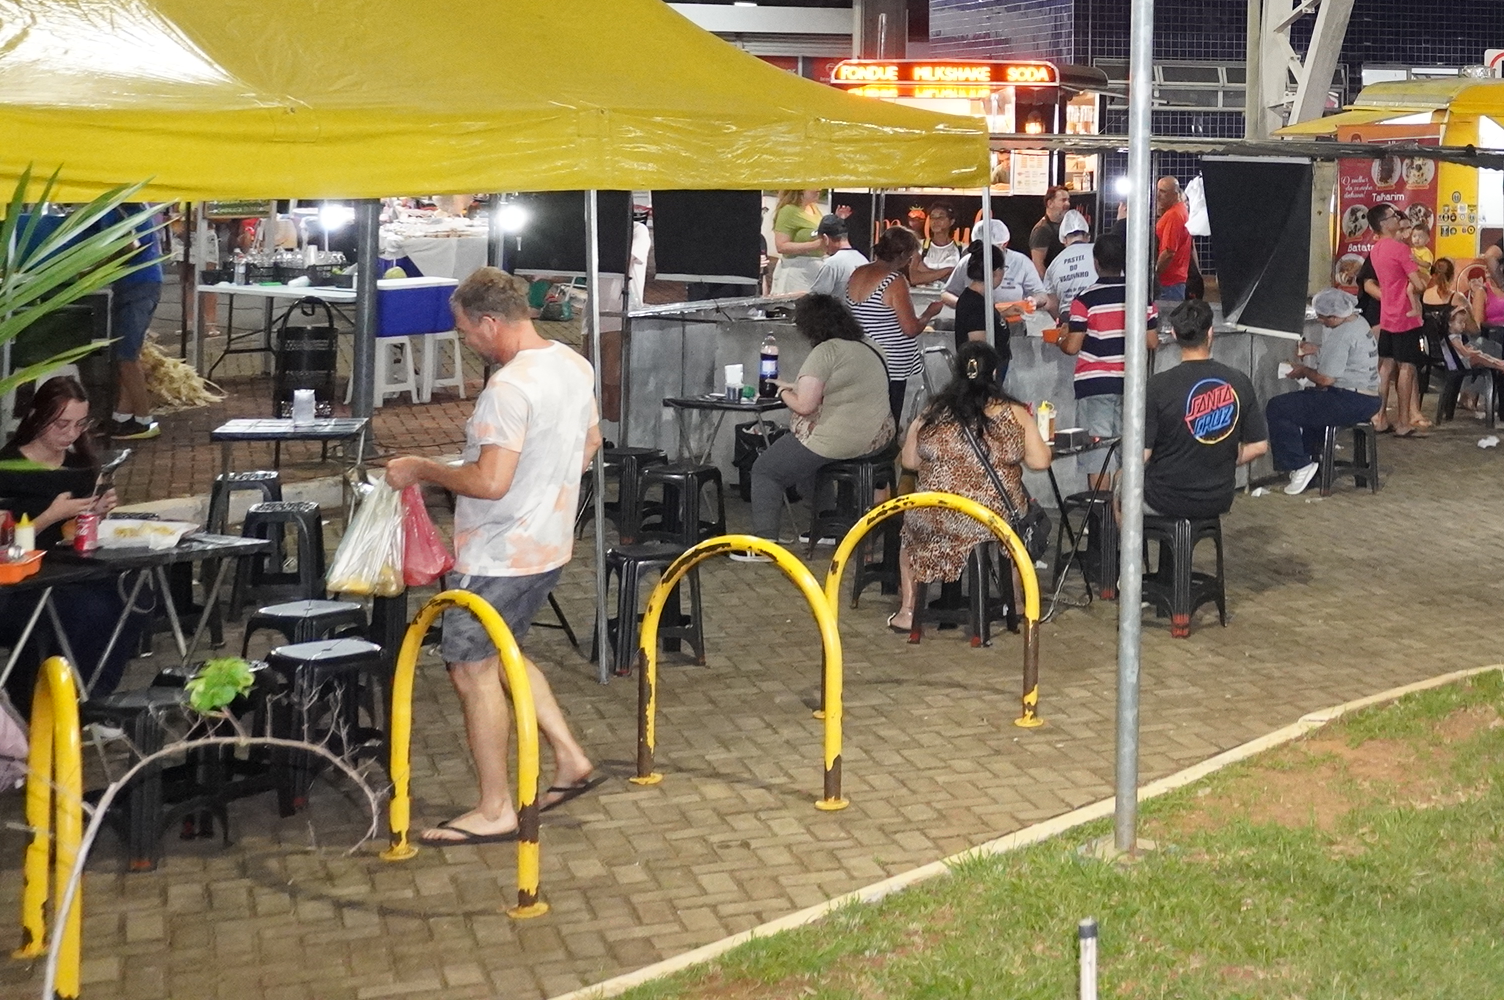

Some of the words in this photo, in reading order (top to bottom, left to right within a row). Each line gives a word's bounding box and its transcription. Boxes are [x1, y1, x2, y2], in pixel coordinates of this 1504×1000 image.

[841, 66, 899, 80] FONDUE
[914, 66, 991, 81] MILKSHAKE
[1007, 66, 1050, 81] SODA
[1064, 254, 1085, 265] PASTEL
[1069, 264, 1078, 272] DO
[1185, 384, 1235, 421] SANTA
[1194, 404, 1234, 437] CRUZ
